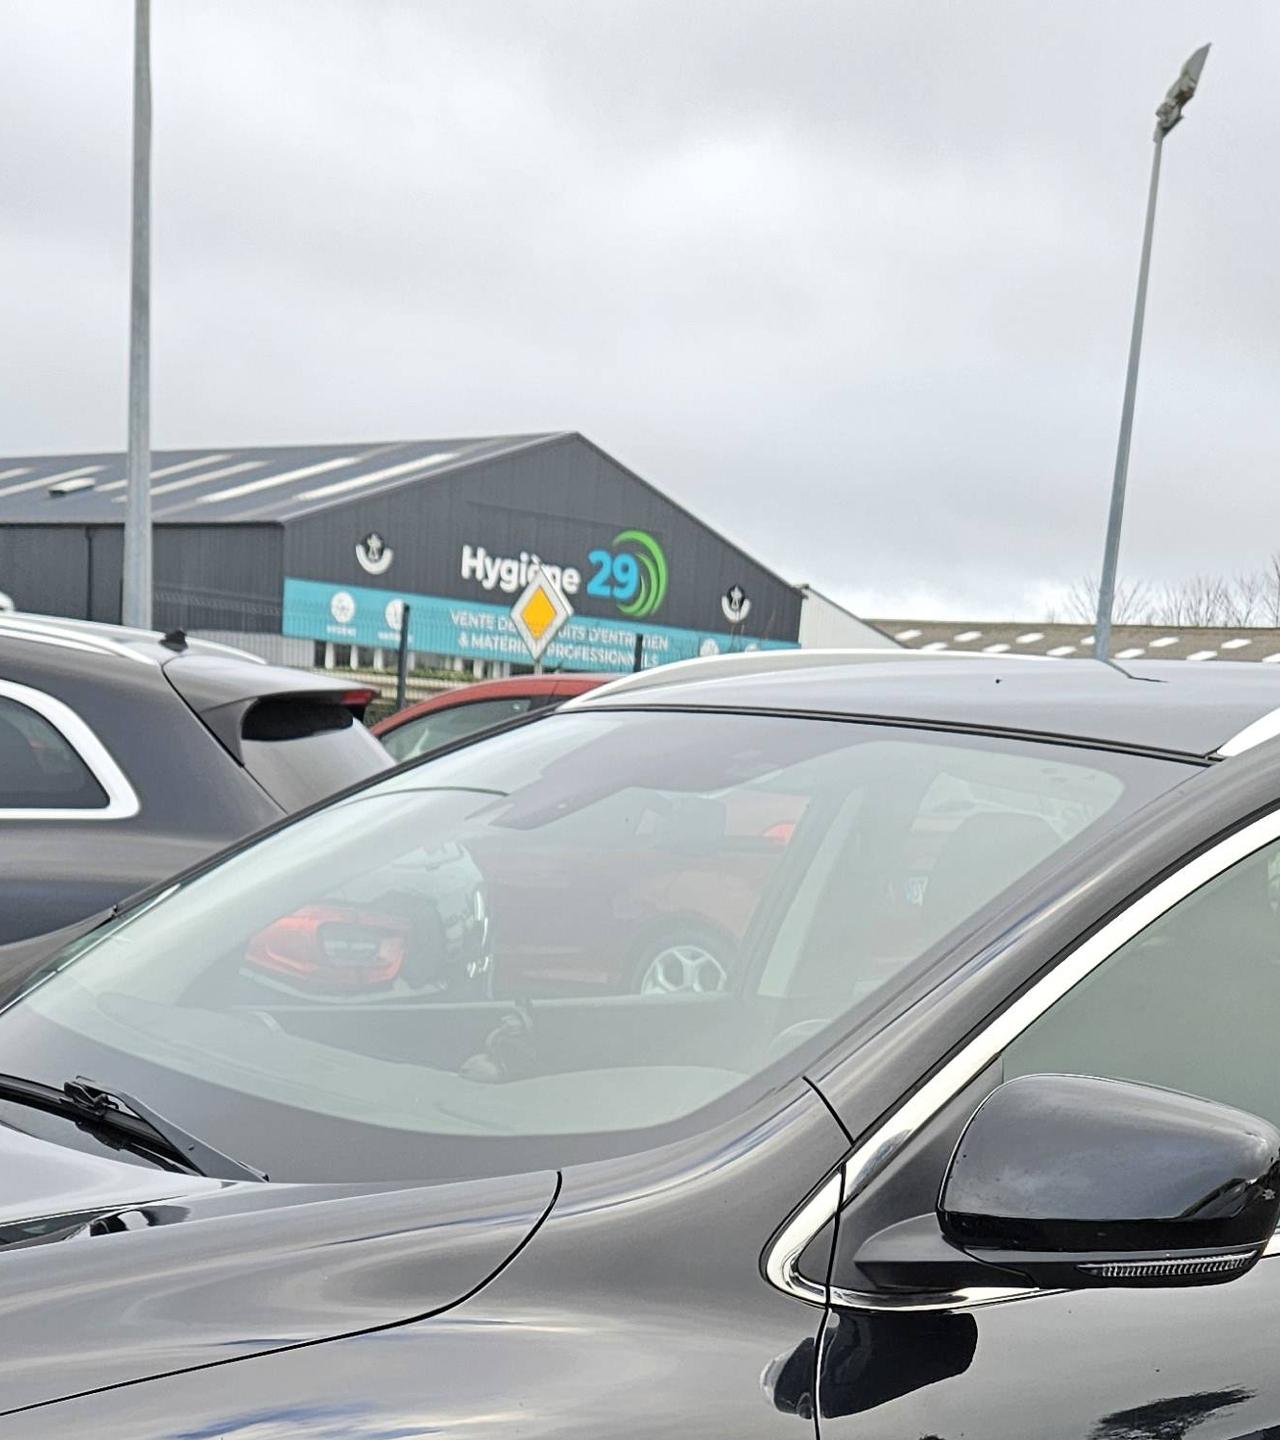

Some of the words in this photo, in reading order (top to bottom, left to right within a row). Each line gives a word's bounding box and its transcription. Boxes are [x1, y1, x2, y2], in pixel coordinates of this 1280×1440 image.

[460, 544, 582, 596] Hygiène
[586, 548, 640, 600] 29
[449, 607, 497, 630] VENTE
